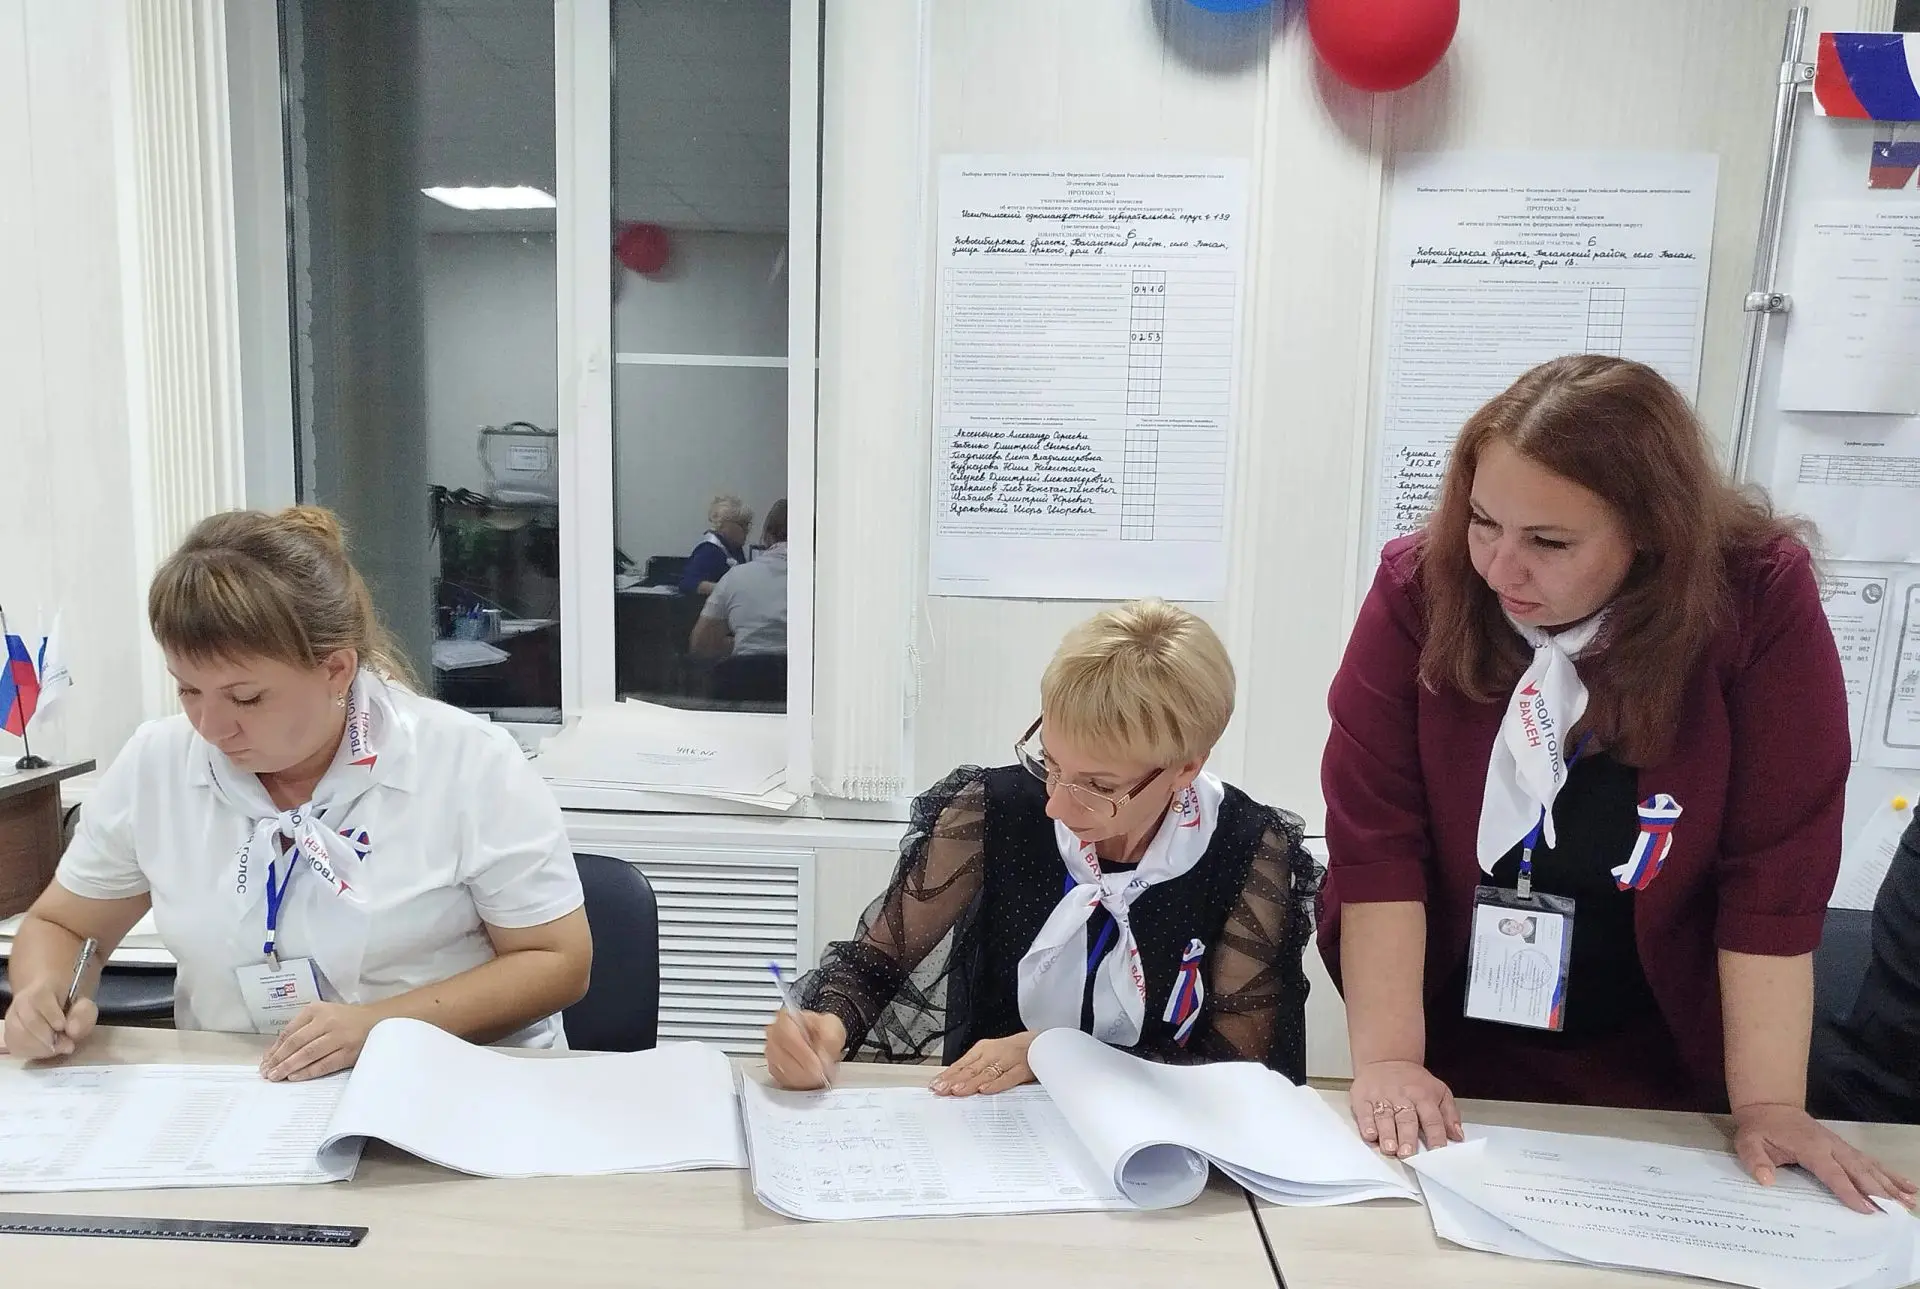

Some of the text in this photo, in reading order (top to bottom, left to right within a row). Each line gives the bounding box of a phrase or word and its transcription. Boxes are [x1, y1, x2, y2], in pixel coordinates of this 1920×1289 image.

[1126, 228, 1138, 240] 6
[1587, 235, 1598, 247] 6
[1519, 701, 1541, 747] ВАЖЕН
[1533, 692, 1561, 784] ТВОЙ ГОЛОС
[236, 846, 250, 895] ГОЛОС
[1523, 1195, 1650, 1218] ИЗБИРАТЕЛЕЙ
[1656, 1213, 1731, 1229] СПИСКА
[1736, 1223, 1796, 1239] КНИГА
